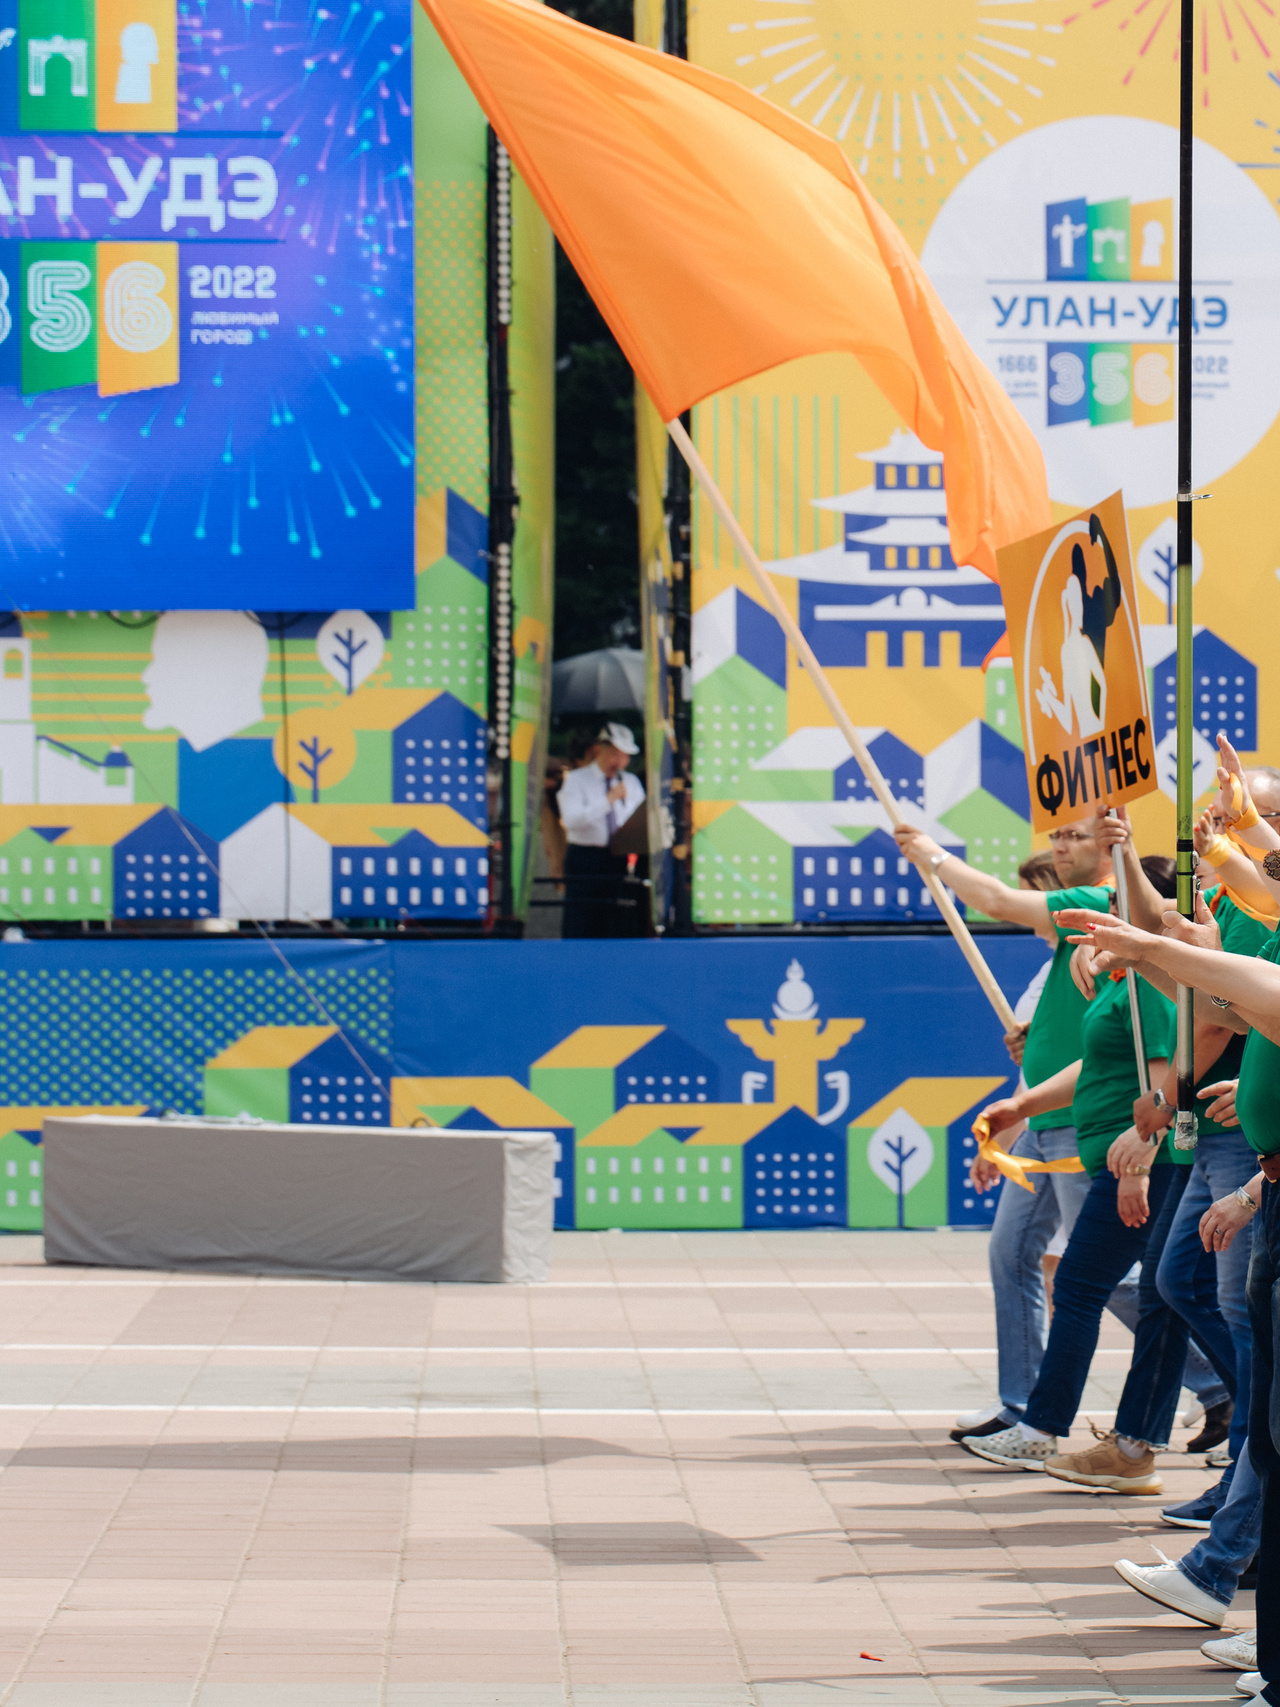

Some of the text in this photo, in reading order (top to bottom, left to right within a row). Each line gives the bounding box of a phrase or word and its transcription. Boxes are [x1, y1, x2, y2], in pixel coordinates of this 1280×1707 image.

[0, 155, 279, 232] Н-УДЭ
[0, 259, 173, 354] 56
[189, 264, 277, 299] 2022
[992, 296, 1229, 335] УЛАН-УДЭ
[1049, 351, 1172, 406] 356
[1193, 355, 1229, 374] 022
[1036, 717, 1151, 817] ФИТНЕС
